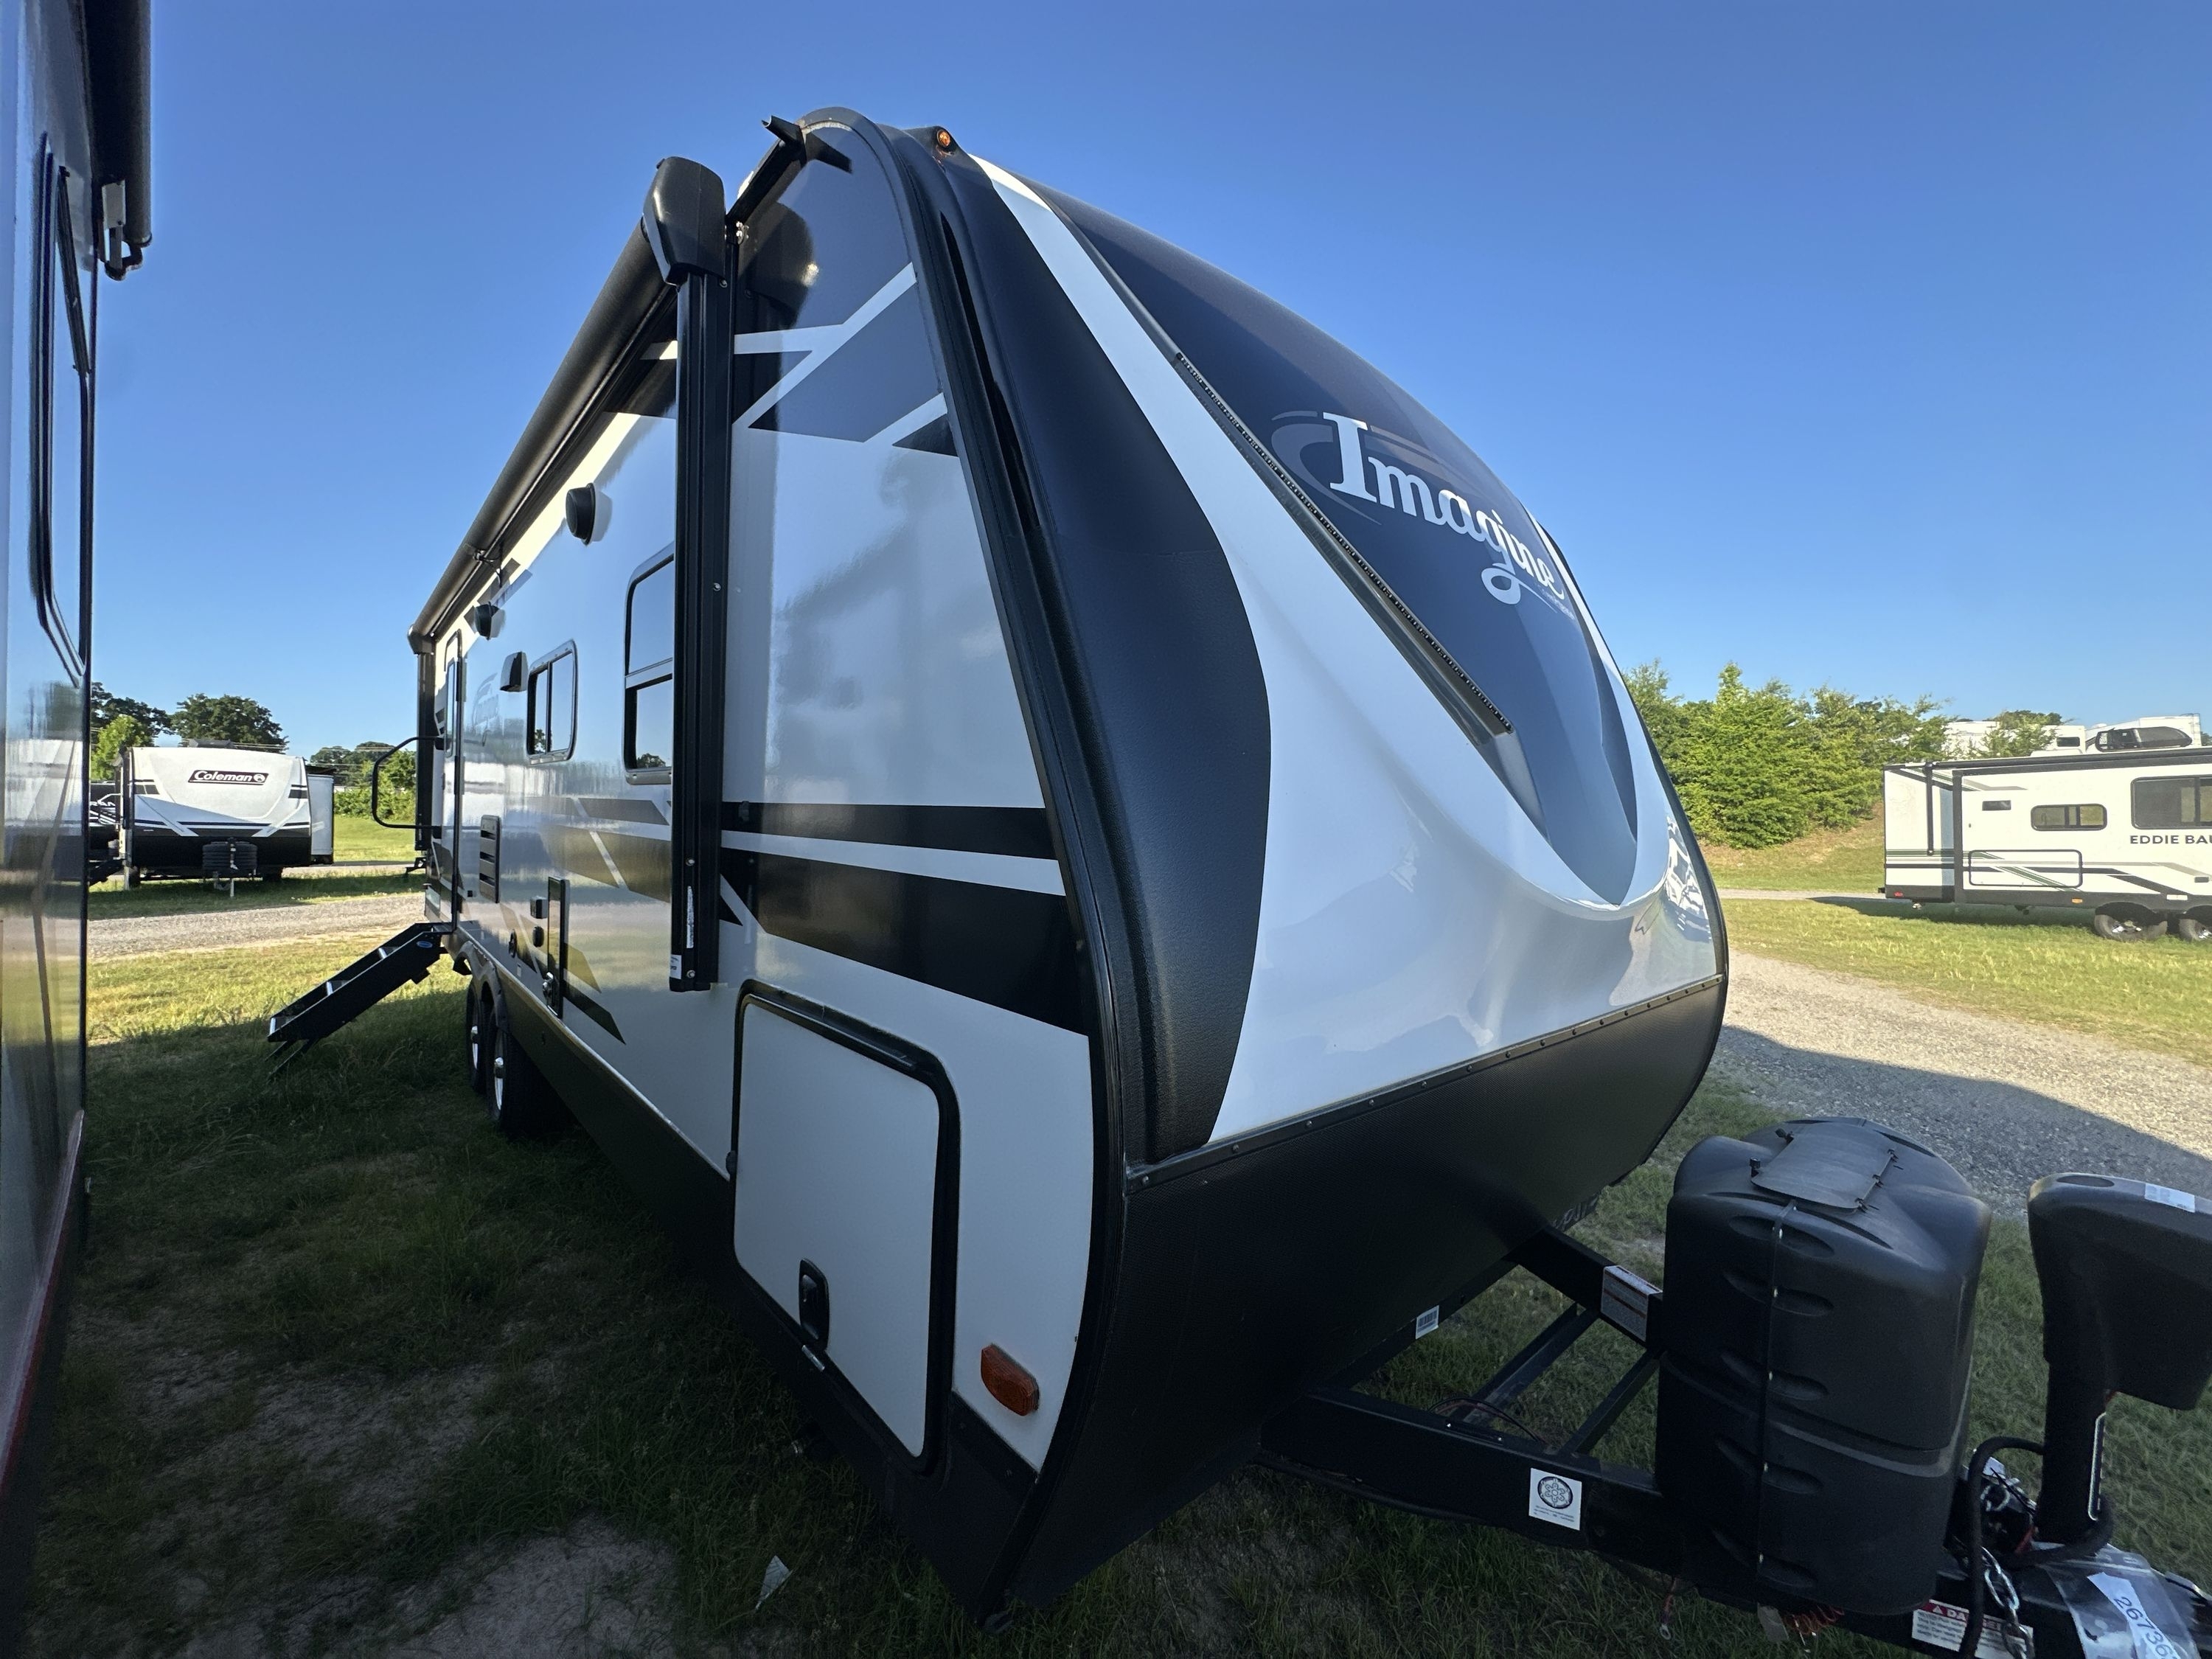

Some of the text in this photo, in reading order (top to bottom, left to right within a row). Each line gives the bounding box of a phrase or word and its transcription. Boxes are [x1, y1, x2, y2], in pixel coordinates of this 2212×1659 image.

[1323, 411, 1565, 605] Imagine
[194, 771, 253, 782] Coleman
[2129, 835, 2179, 844] EDDIE
[2112, 1596, 2179, 1659] 26736
